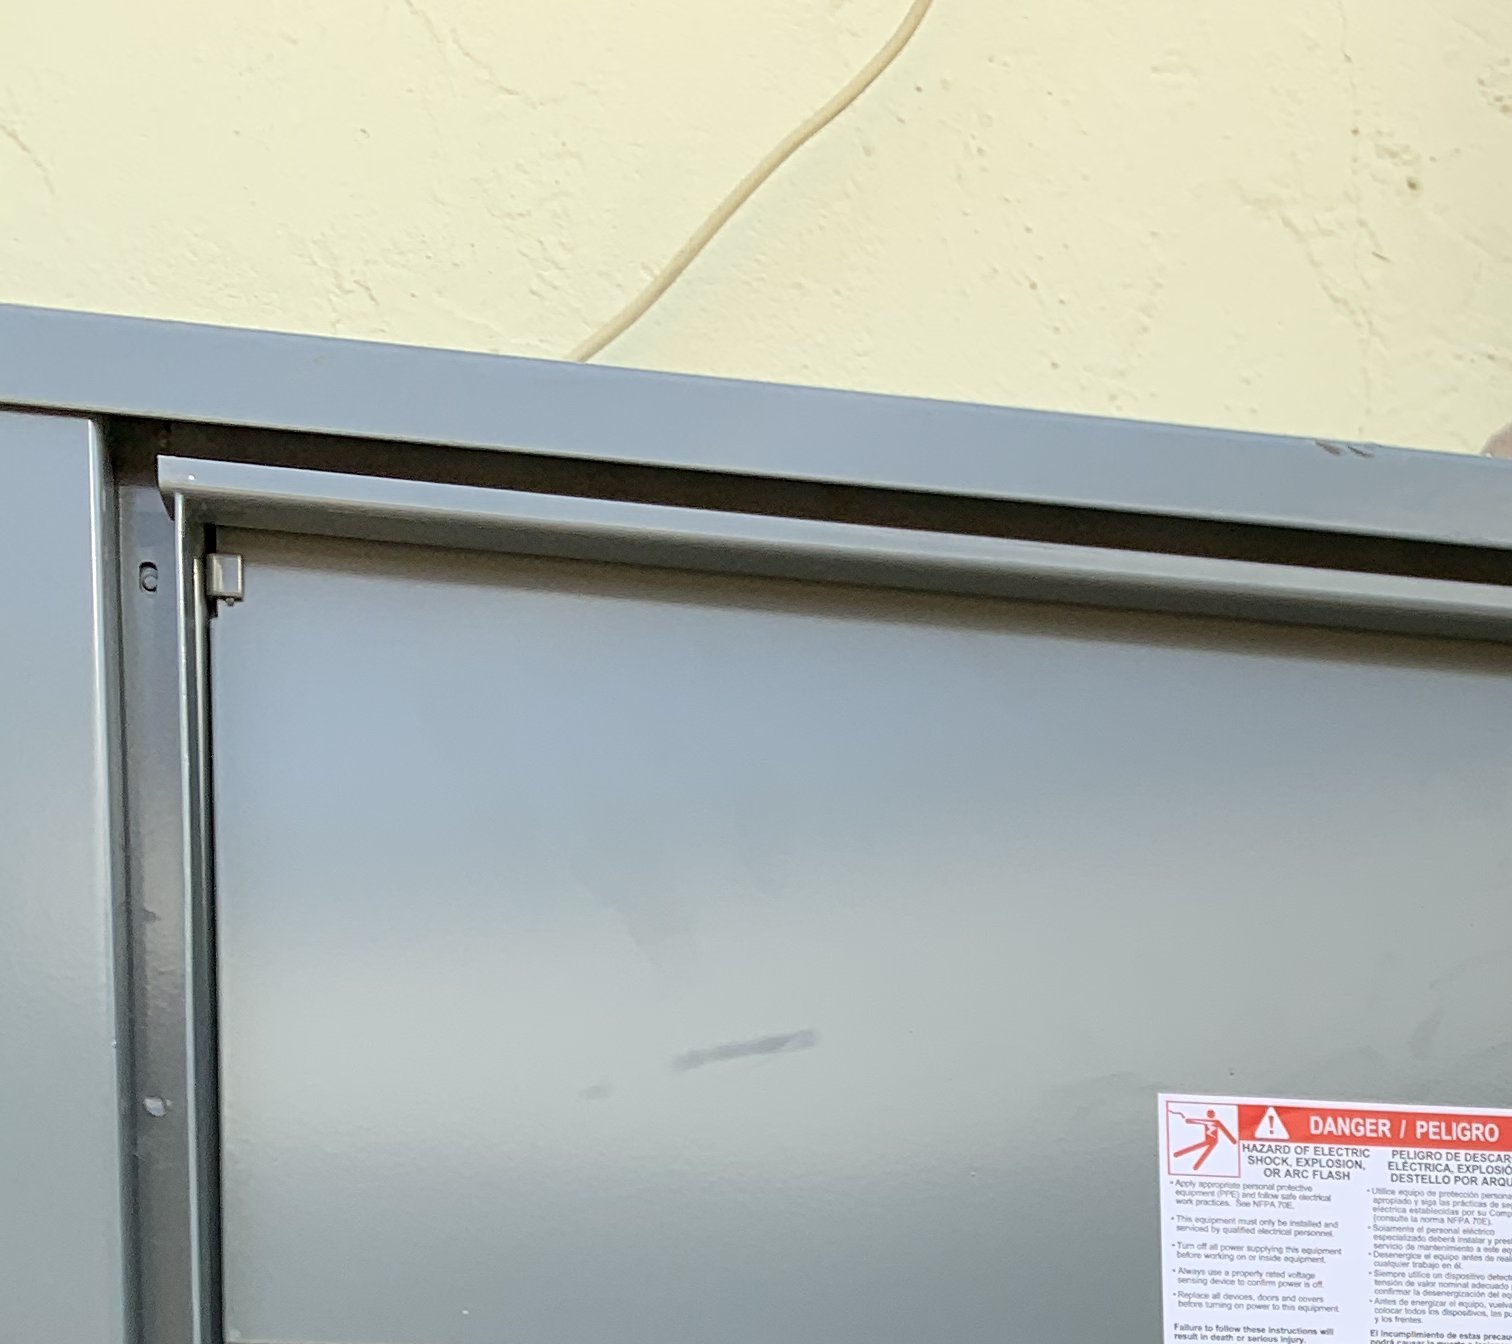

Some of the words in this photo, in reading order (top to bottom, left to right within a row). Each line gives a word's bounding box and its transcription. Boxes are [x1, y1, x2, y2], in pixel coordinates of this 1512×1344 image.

[1309, 1115, 1392, 1138] DANGER
[1415, 1120, 1500, 1143] PELIGRO
[1241, 1142, 1291, 1155] HAZARD
[1293, 1145, 1310, 1156] OF
[1313, 1145, 1371, 1159] ELECTRIC
[1391, 1149, 1443, 1161] PELIGRO
[1445, 1151, 1461, 1162] DE
[1247, 1155, 1293, 1168] SHOCK,
[1295, 1157, 1366, 1171] EXPLOSION,
[1387, 1159, 1454, 1174] ELÉCTRICA,
[1263, 1167, 1282, 1179] OR
[1283, 1168, 1309, 1179] ARC
[1312, 1169, 1351, 1181] FLASH
[1390, 1172, 1451, 1185] DESTELLO
[1453, 1175, 1479, 1186] POR
